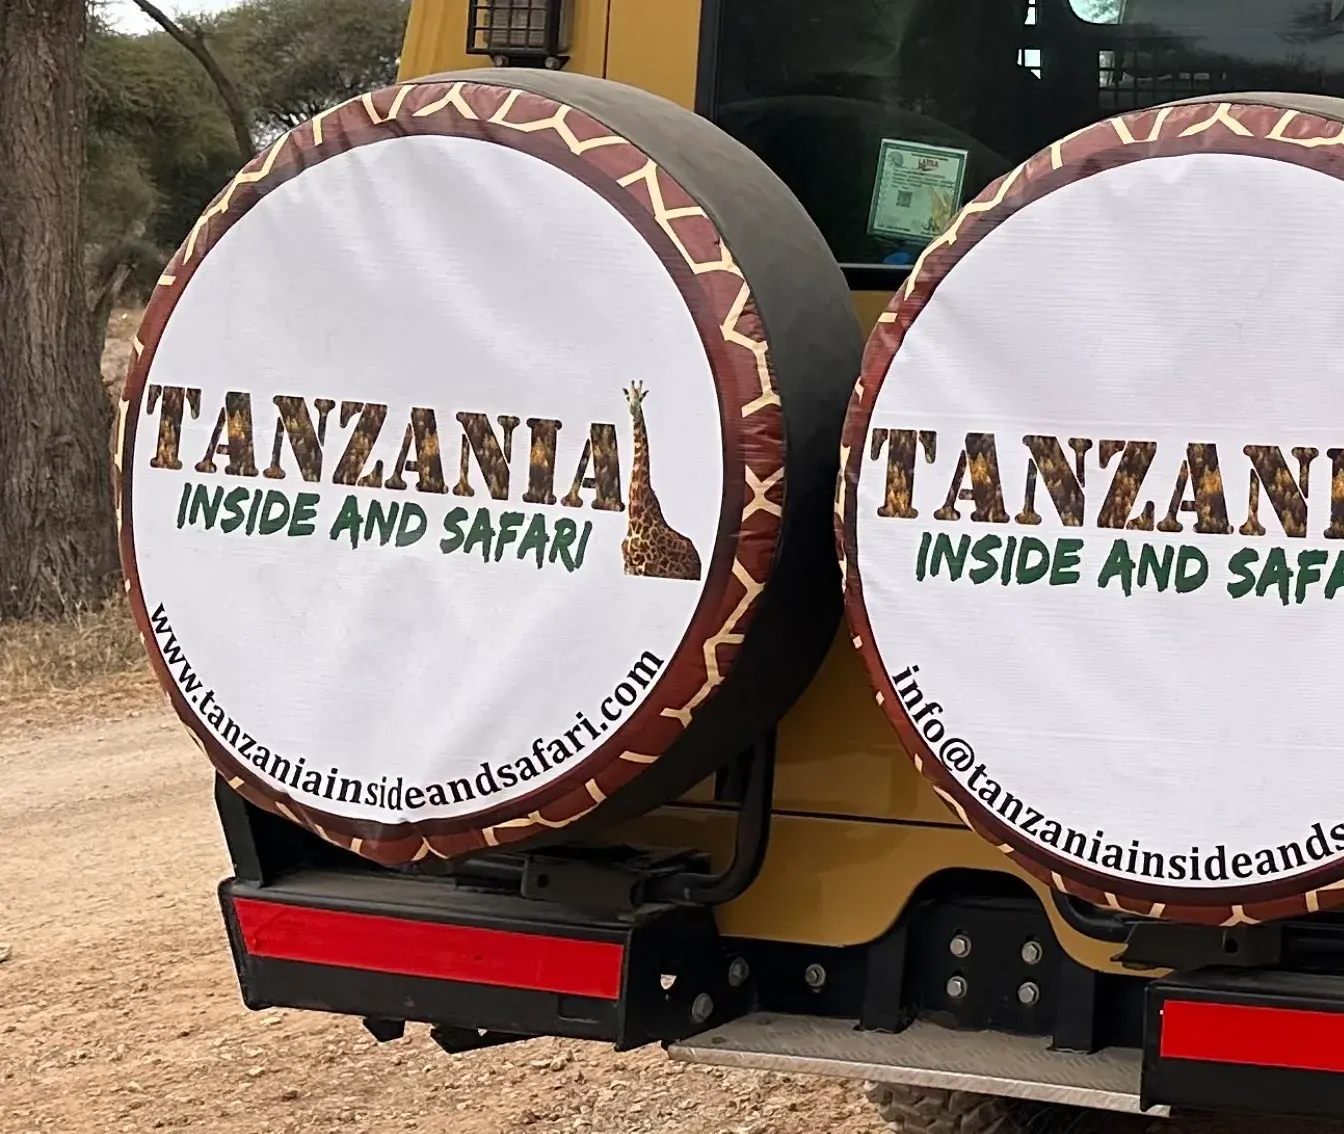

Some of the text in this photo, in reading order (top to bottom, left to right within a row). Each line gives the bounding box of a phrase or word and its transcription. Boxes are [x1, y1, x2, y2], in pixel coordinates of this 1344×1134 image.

[146, 383, 625, 512] TANZANIA
[176, 482, 593, 573] INSIDE AND SAFARI
[915, 531, 1084, 587] INSIDE
[1098, 538, 1210, 598] AND
[149, 602, 664, 812] www.tanzaniainsideandsafari.com
